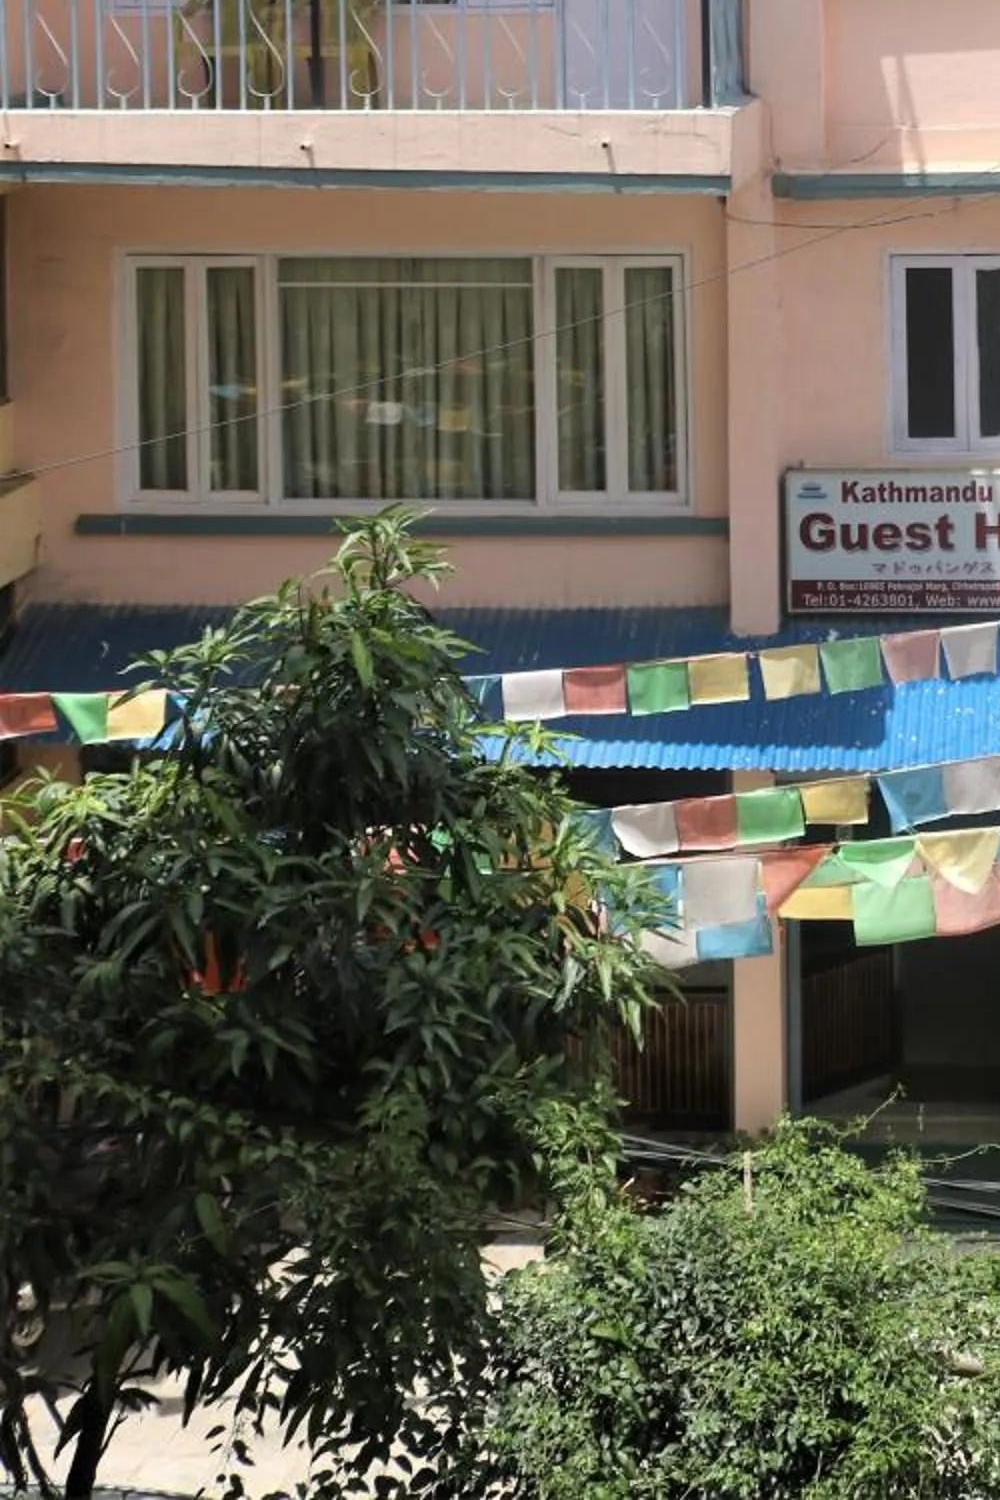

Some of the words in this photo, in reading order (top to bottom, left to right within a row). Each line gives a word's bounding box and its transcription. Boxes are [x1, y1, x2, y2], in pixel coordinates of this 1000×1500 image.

[841, 480, 993, 503] Kathmandu
[799, 512, 956, 552] Guest
[925, 593, 961, 608] Web:
